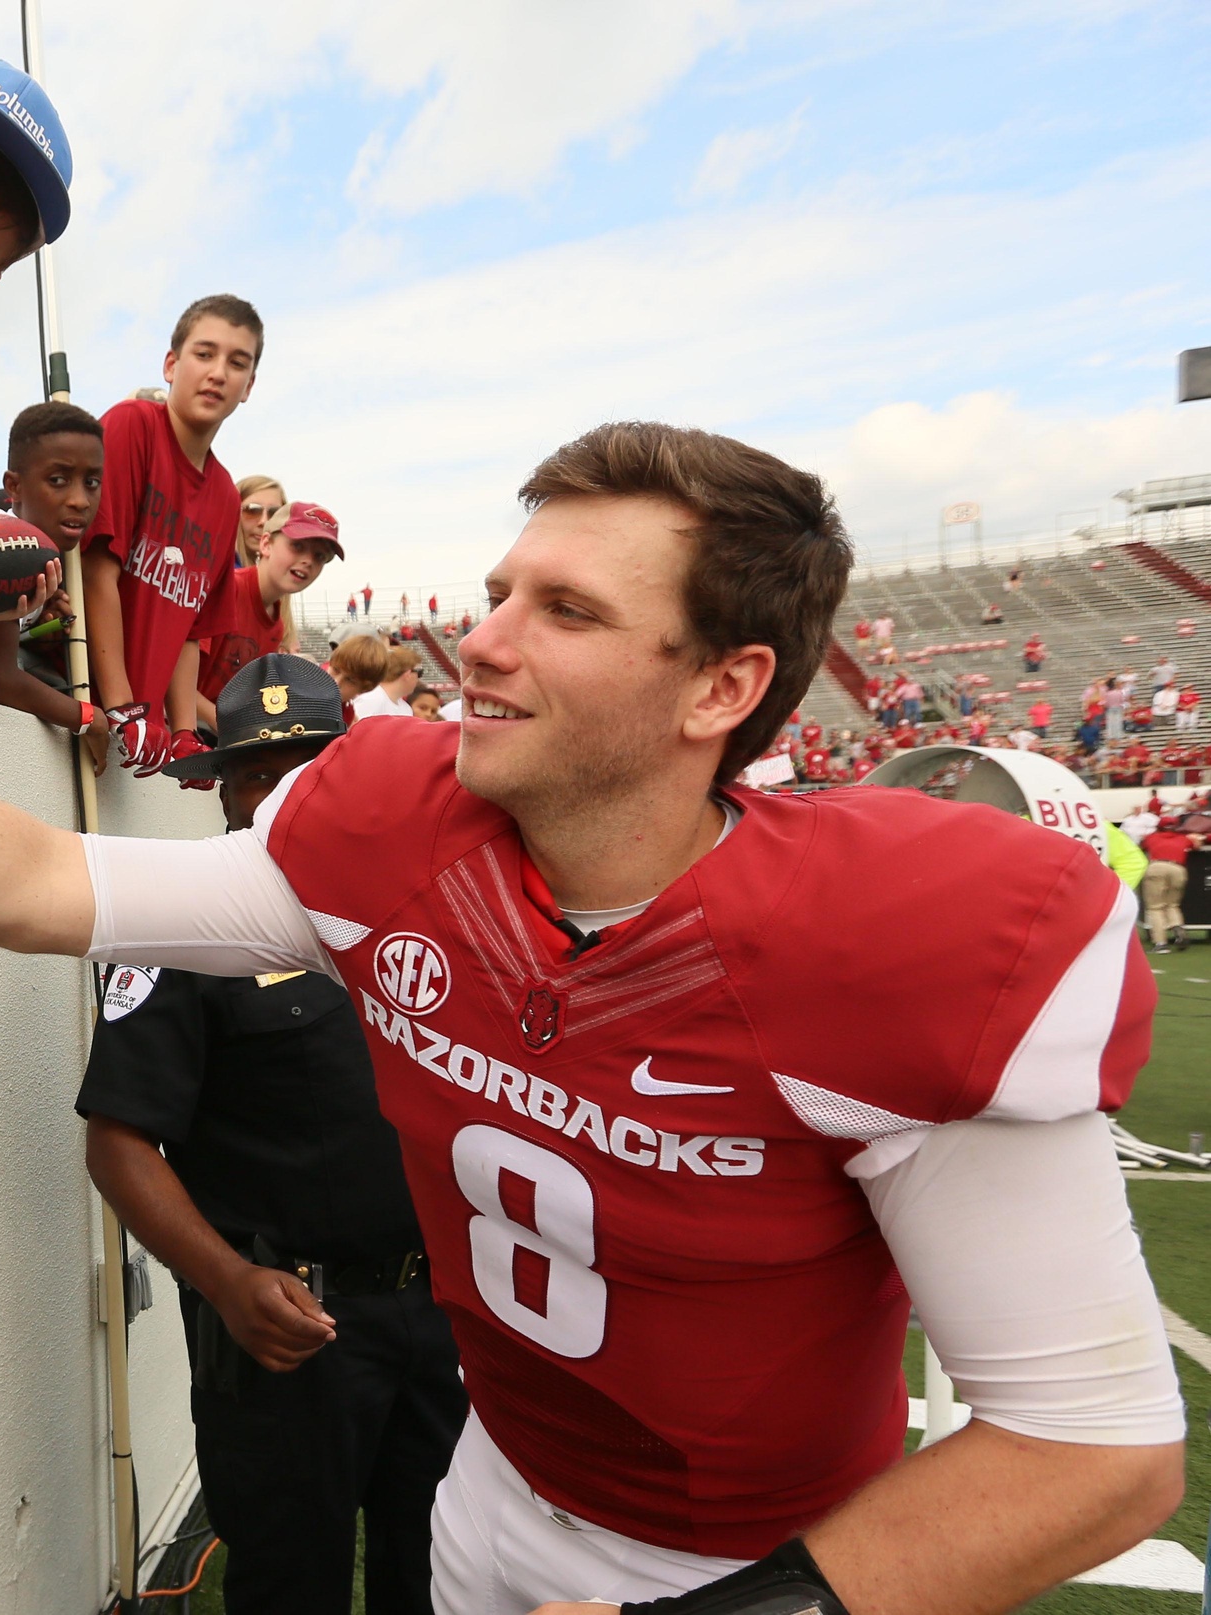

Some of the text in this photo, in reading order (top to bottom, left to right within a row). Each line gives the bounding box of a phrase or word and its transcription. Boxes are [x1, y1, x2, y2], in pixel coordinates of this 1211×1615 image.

[1036, 800, 1098, 829] BIG
[377, 939, 443, 1011] SEC
[358, 987, 766, 1177] RAZORBACKS
[451, 1123, 608, 1359] 8
